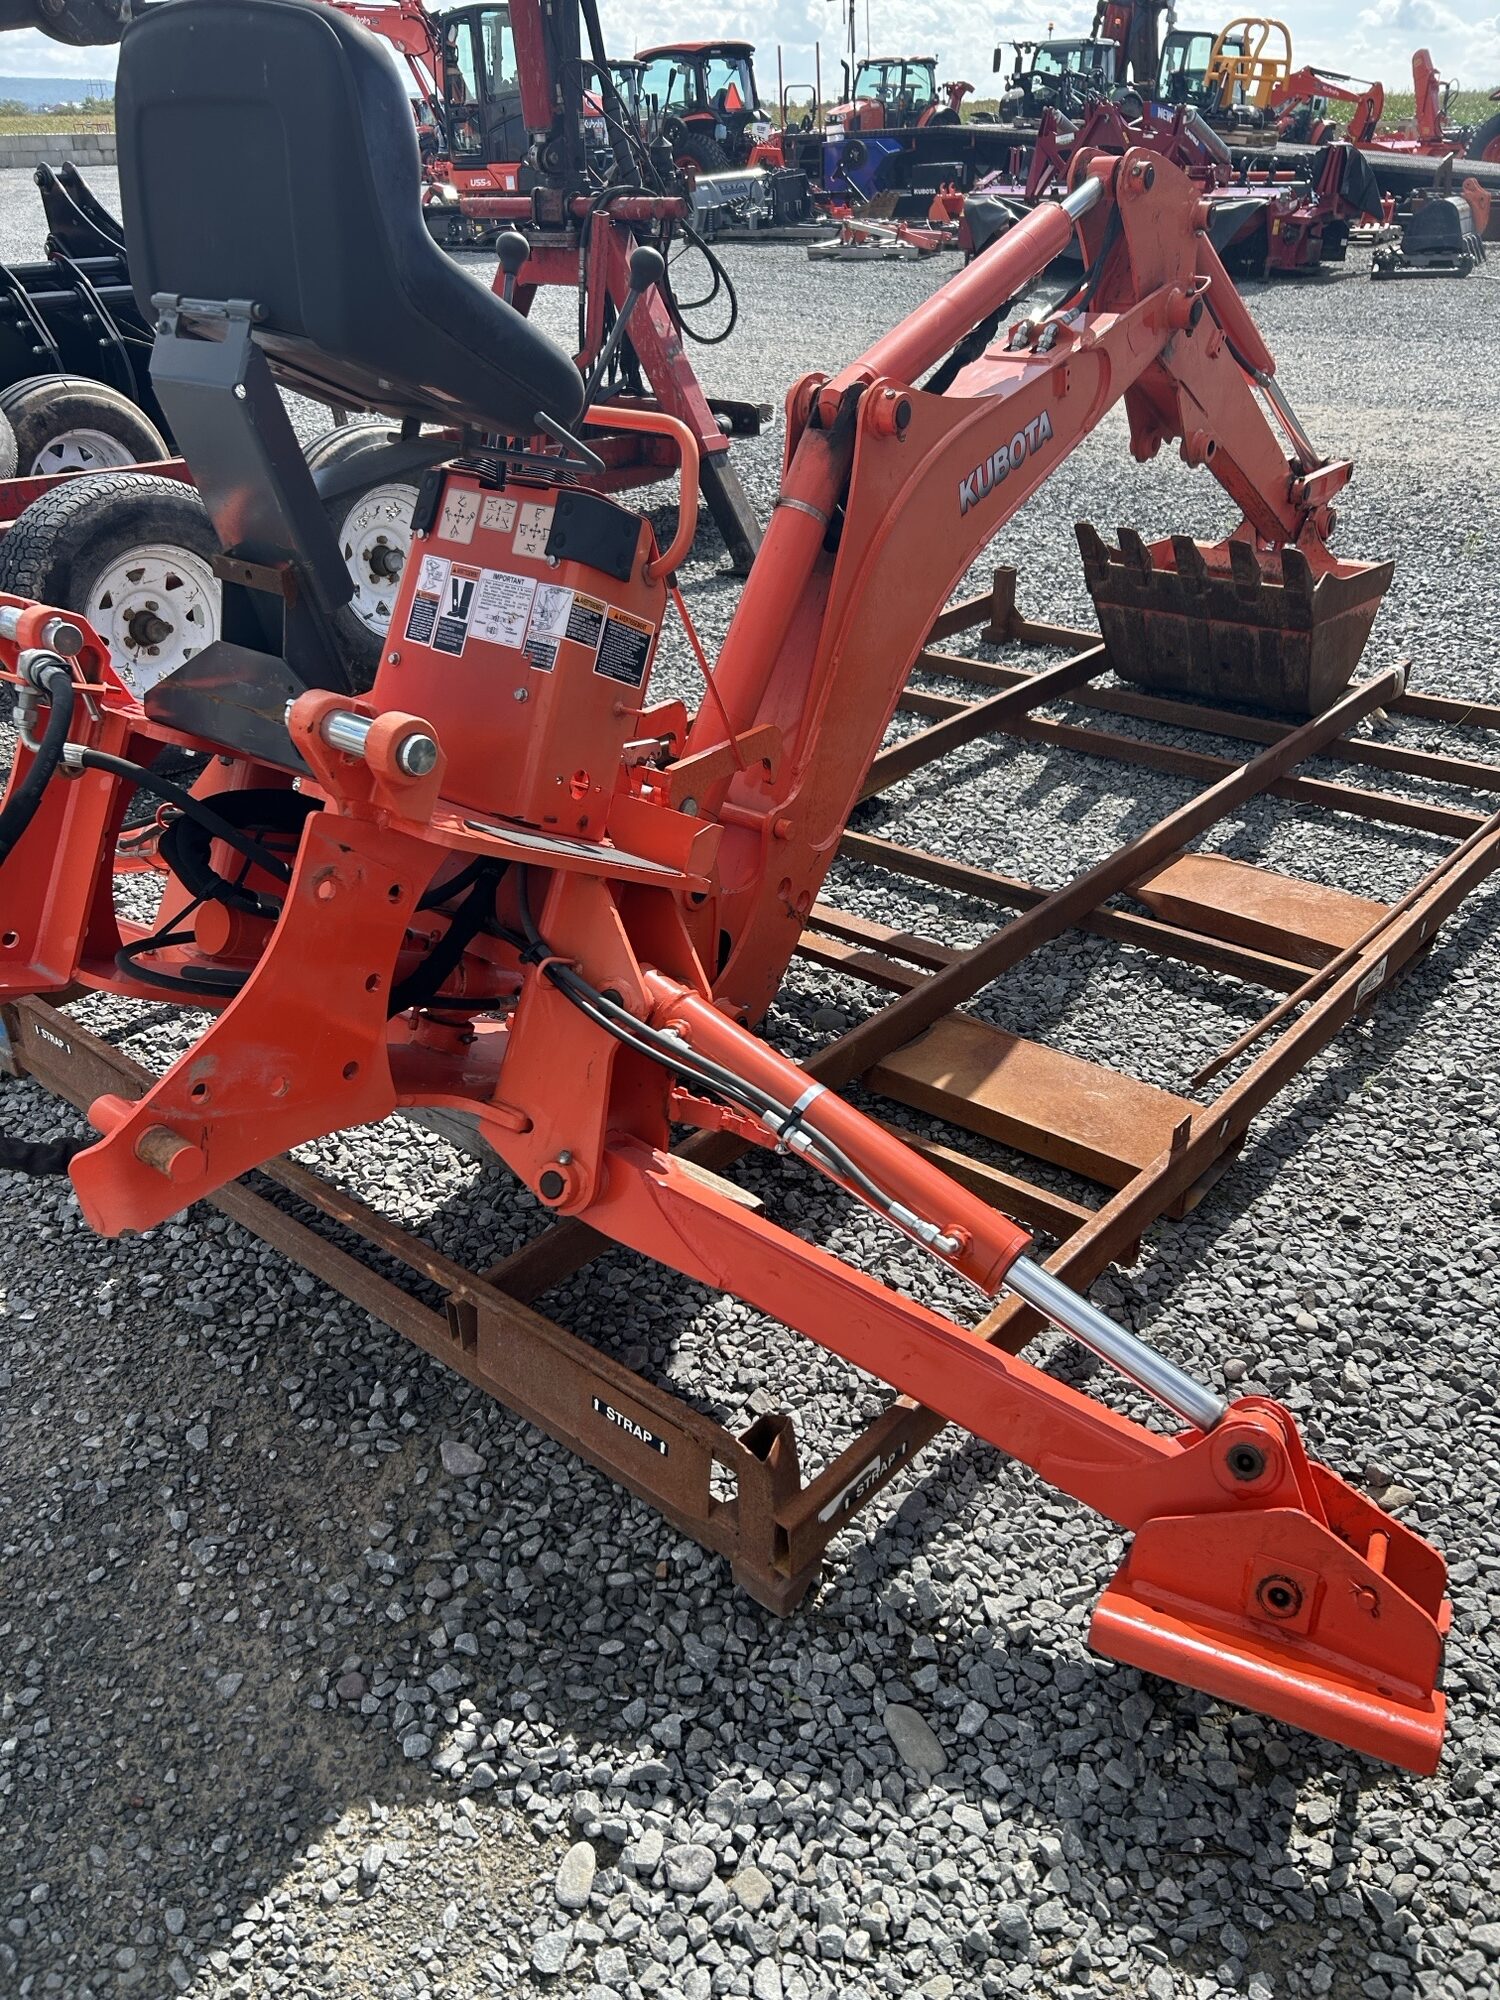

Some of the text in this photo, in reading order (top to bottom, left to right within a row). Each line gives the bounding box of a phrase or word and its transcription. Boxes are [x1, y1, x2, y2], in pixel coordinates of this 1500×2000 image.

[959, 409, 1054, 516] KUBOTA
[493, 573, 525, 586] IMPORTANT
[41, 1028, 64, 1049] STRAP
[606, 1406, 652, 1443] STRAP
[855, 1454, 897, 1497] STRAP
